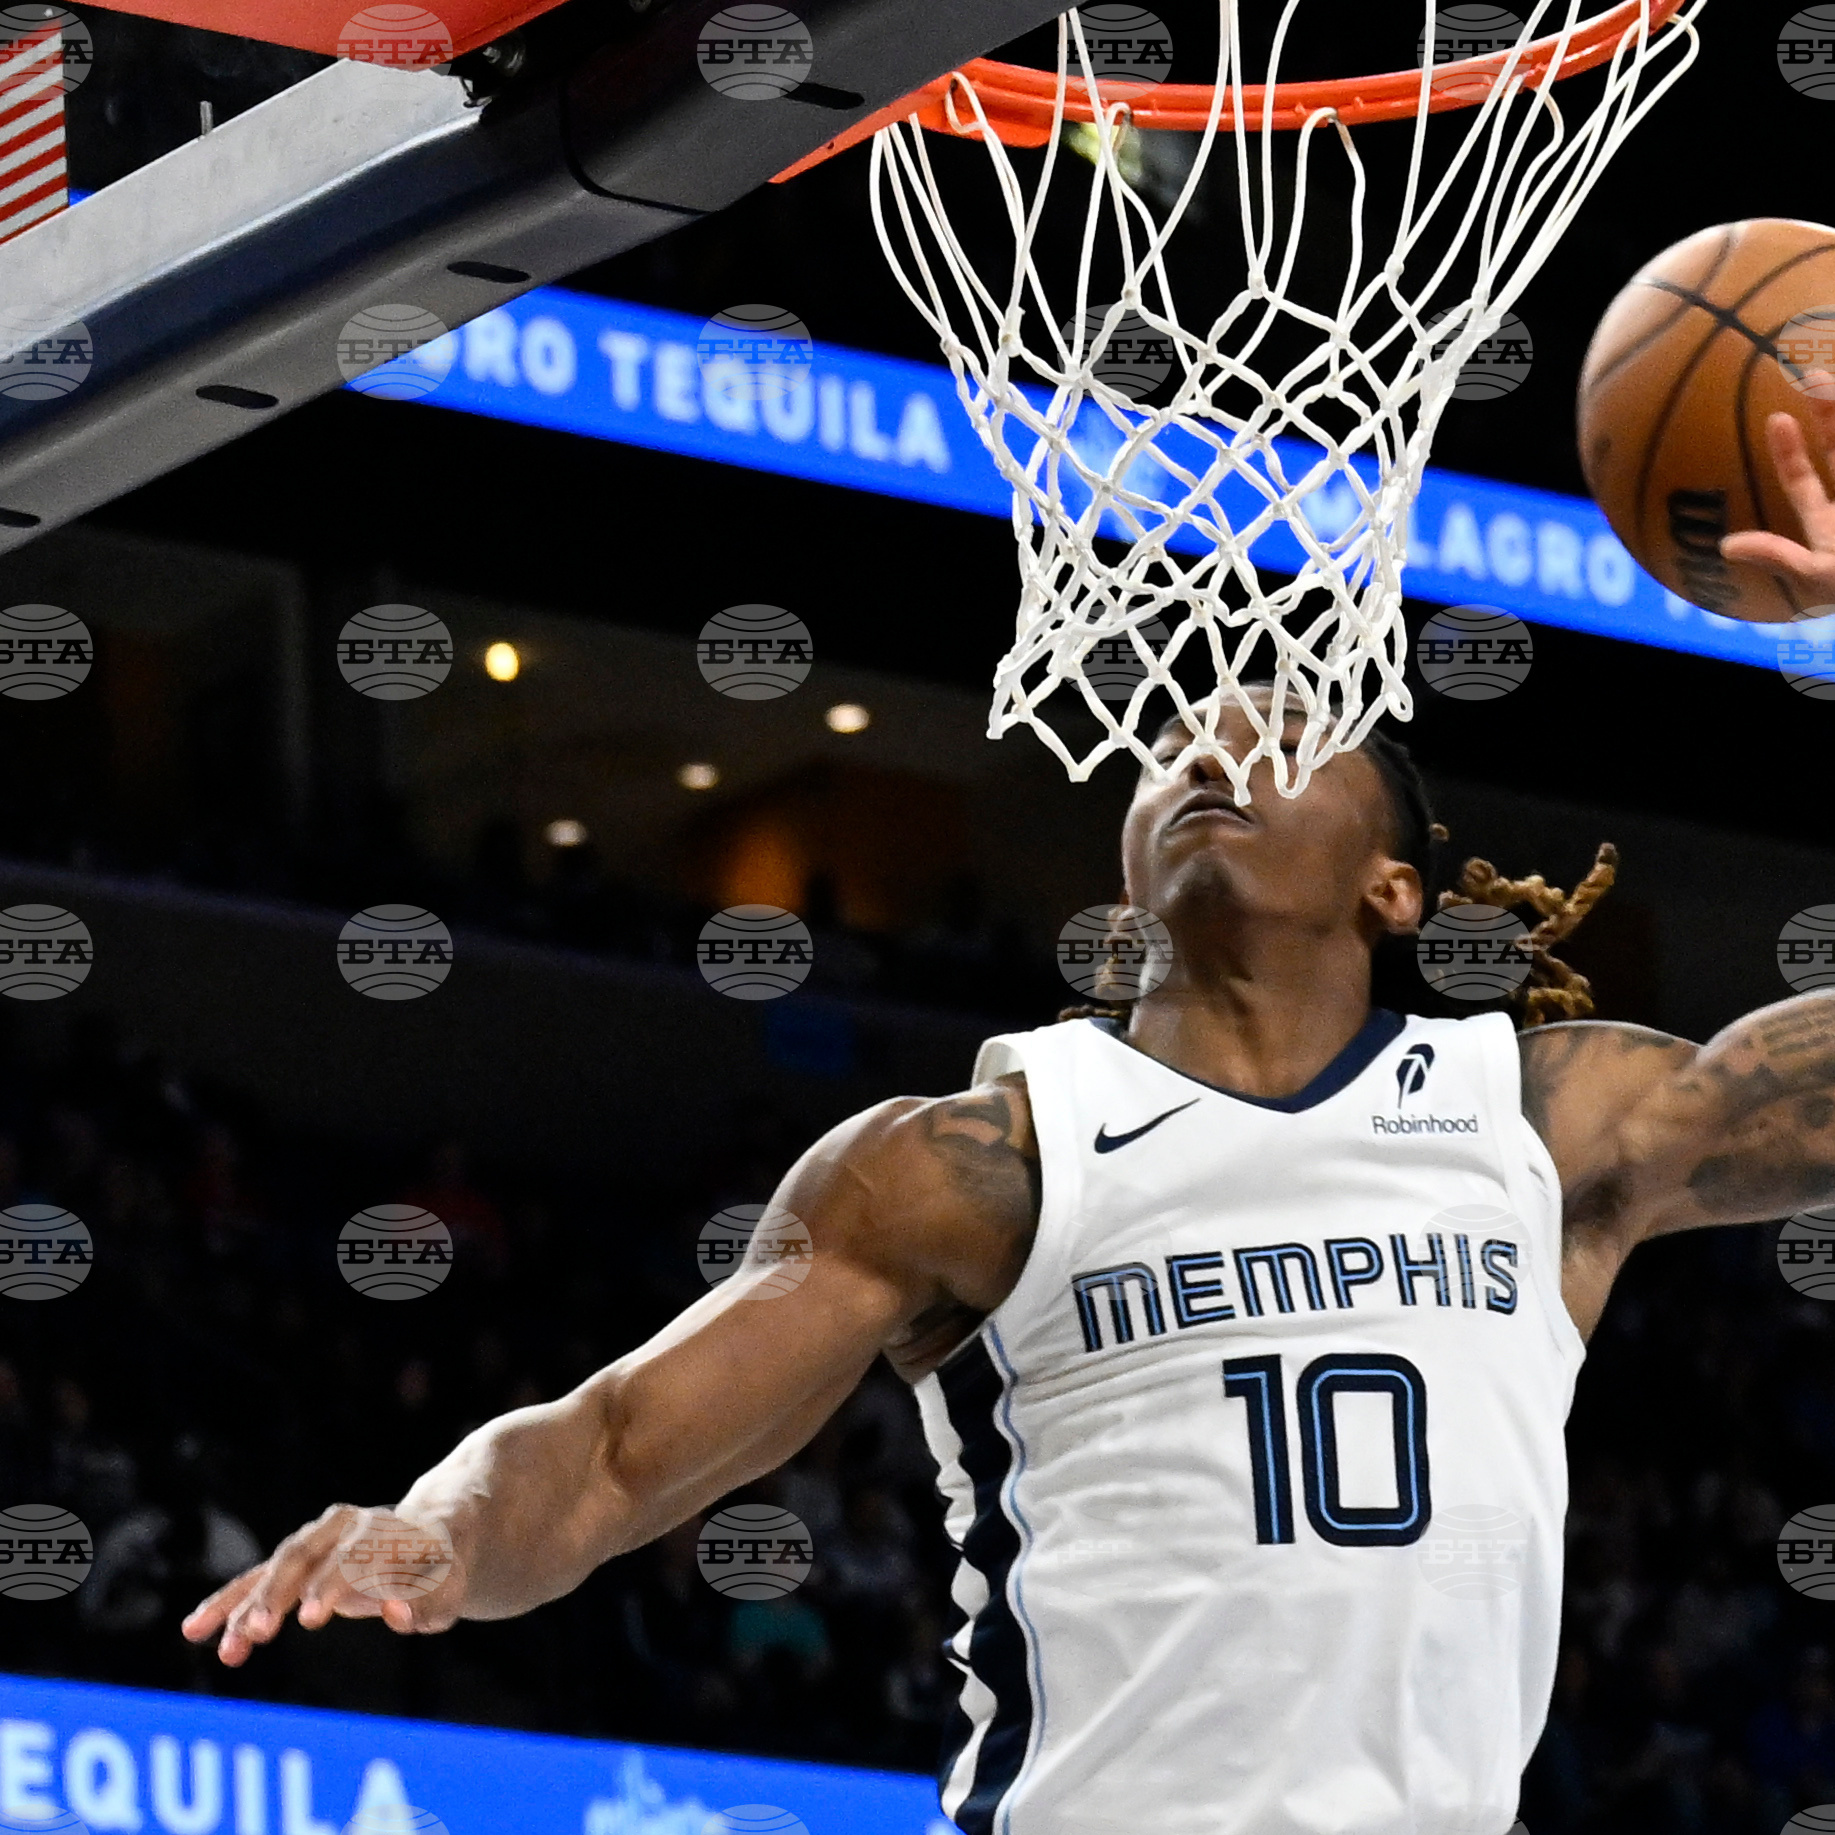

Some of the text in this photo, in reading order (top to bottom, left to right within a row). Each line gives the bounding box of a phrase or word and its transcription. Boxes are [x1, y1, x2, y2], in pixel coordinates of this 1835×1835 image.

[599, 330, 951, 473] TEQUILA
[1302, 482, 1636, 607] MLAGRO
[1371, 1114, 1479, 1136] Robinhood
[1071, 1232, 1518, 1354] MEMPHIS
[1222, 1353, 1433, 1547] 10
